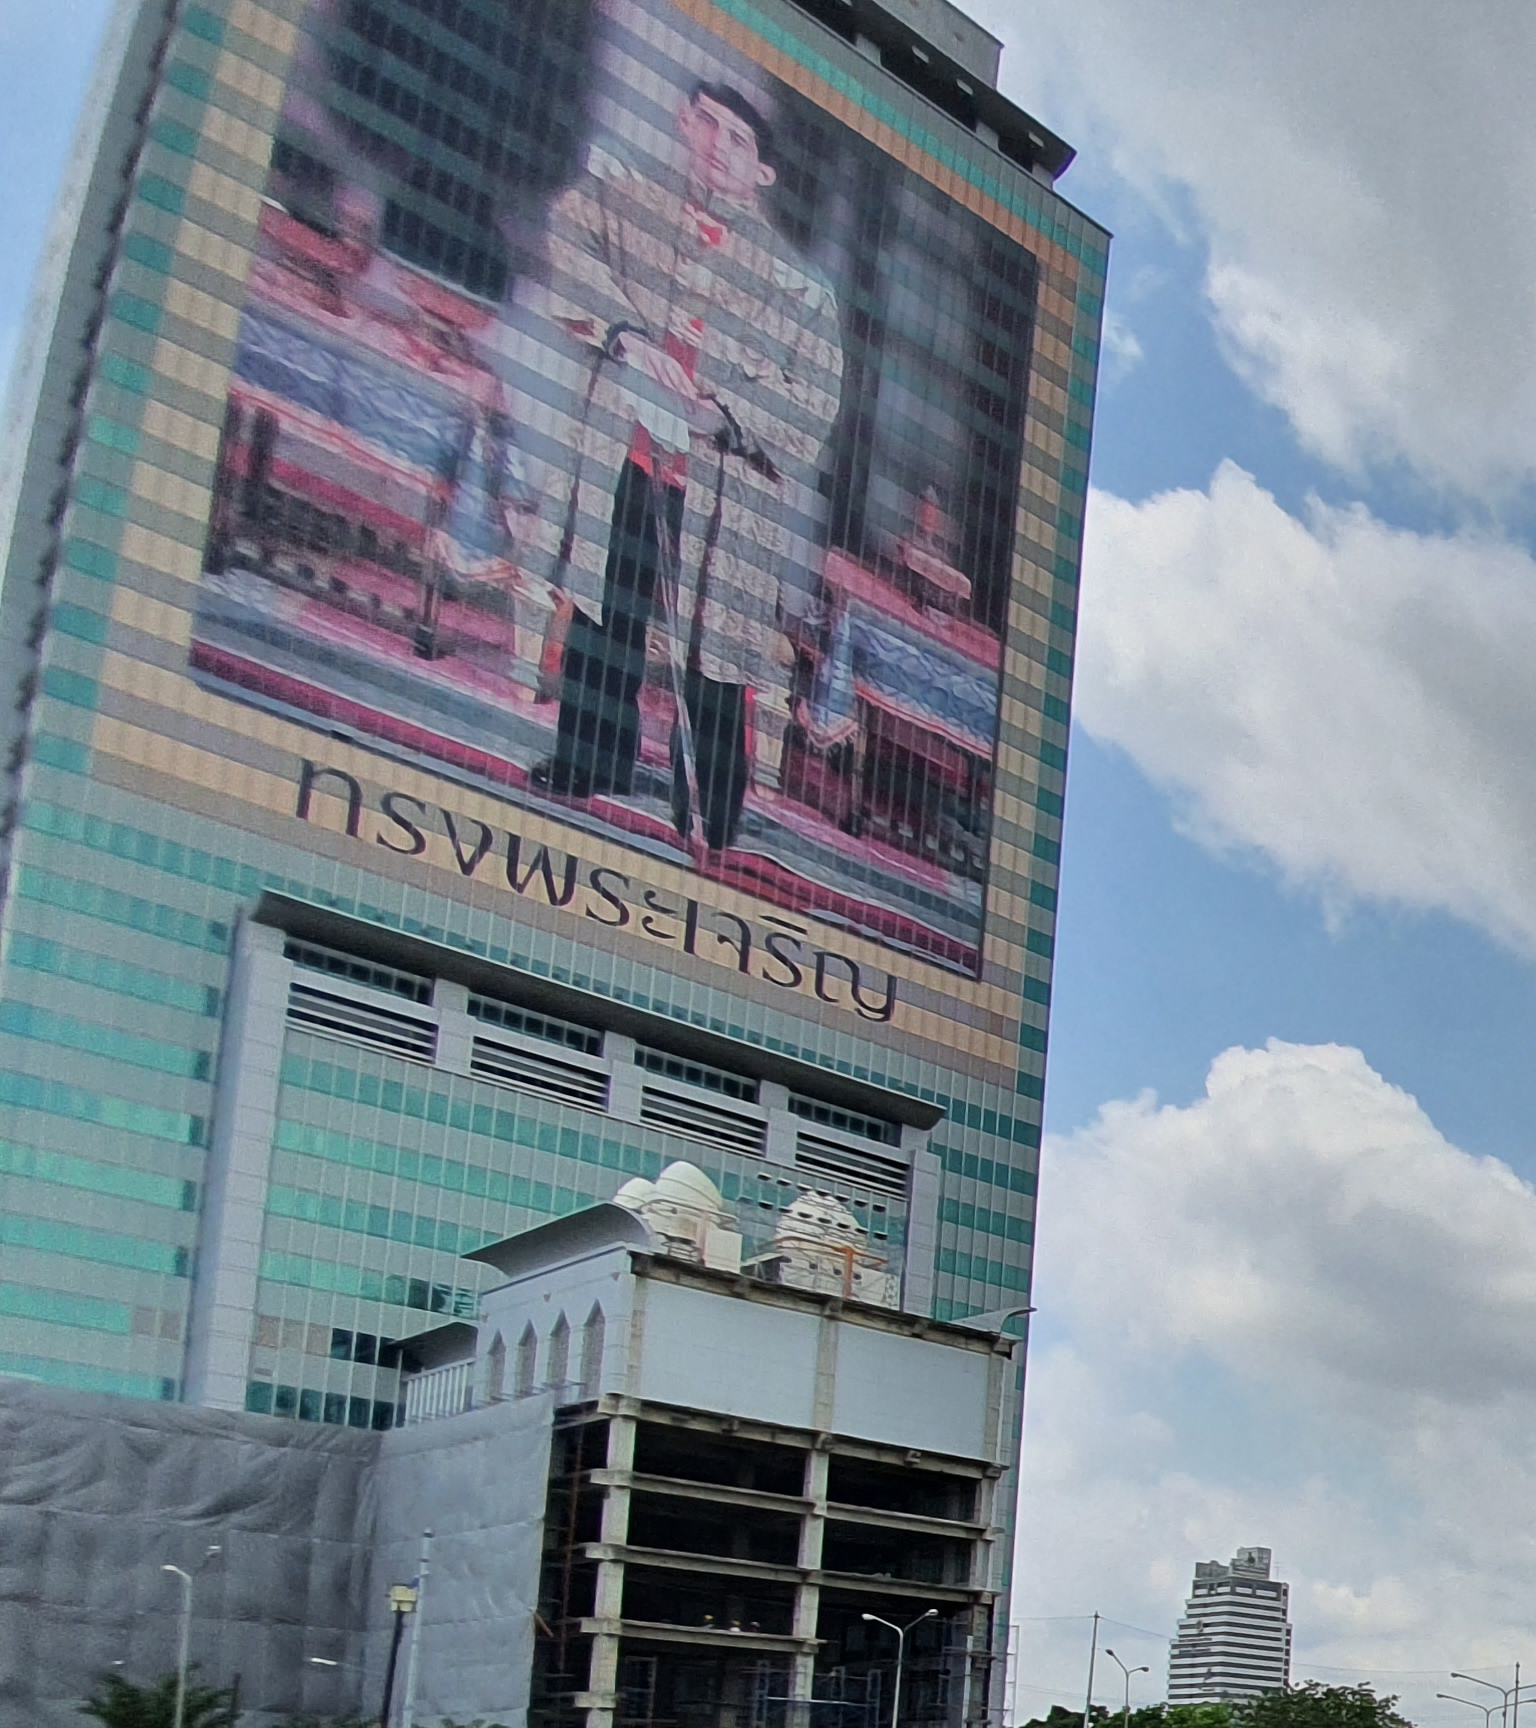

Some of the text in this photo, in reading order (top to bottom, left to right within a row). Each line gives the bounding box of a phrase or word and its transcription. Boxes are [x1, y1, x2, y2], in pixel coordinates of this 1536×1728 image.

[296, 759, 897, 1022] ทรงพระเจริญ
